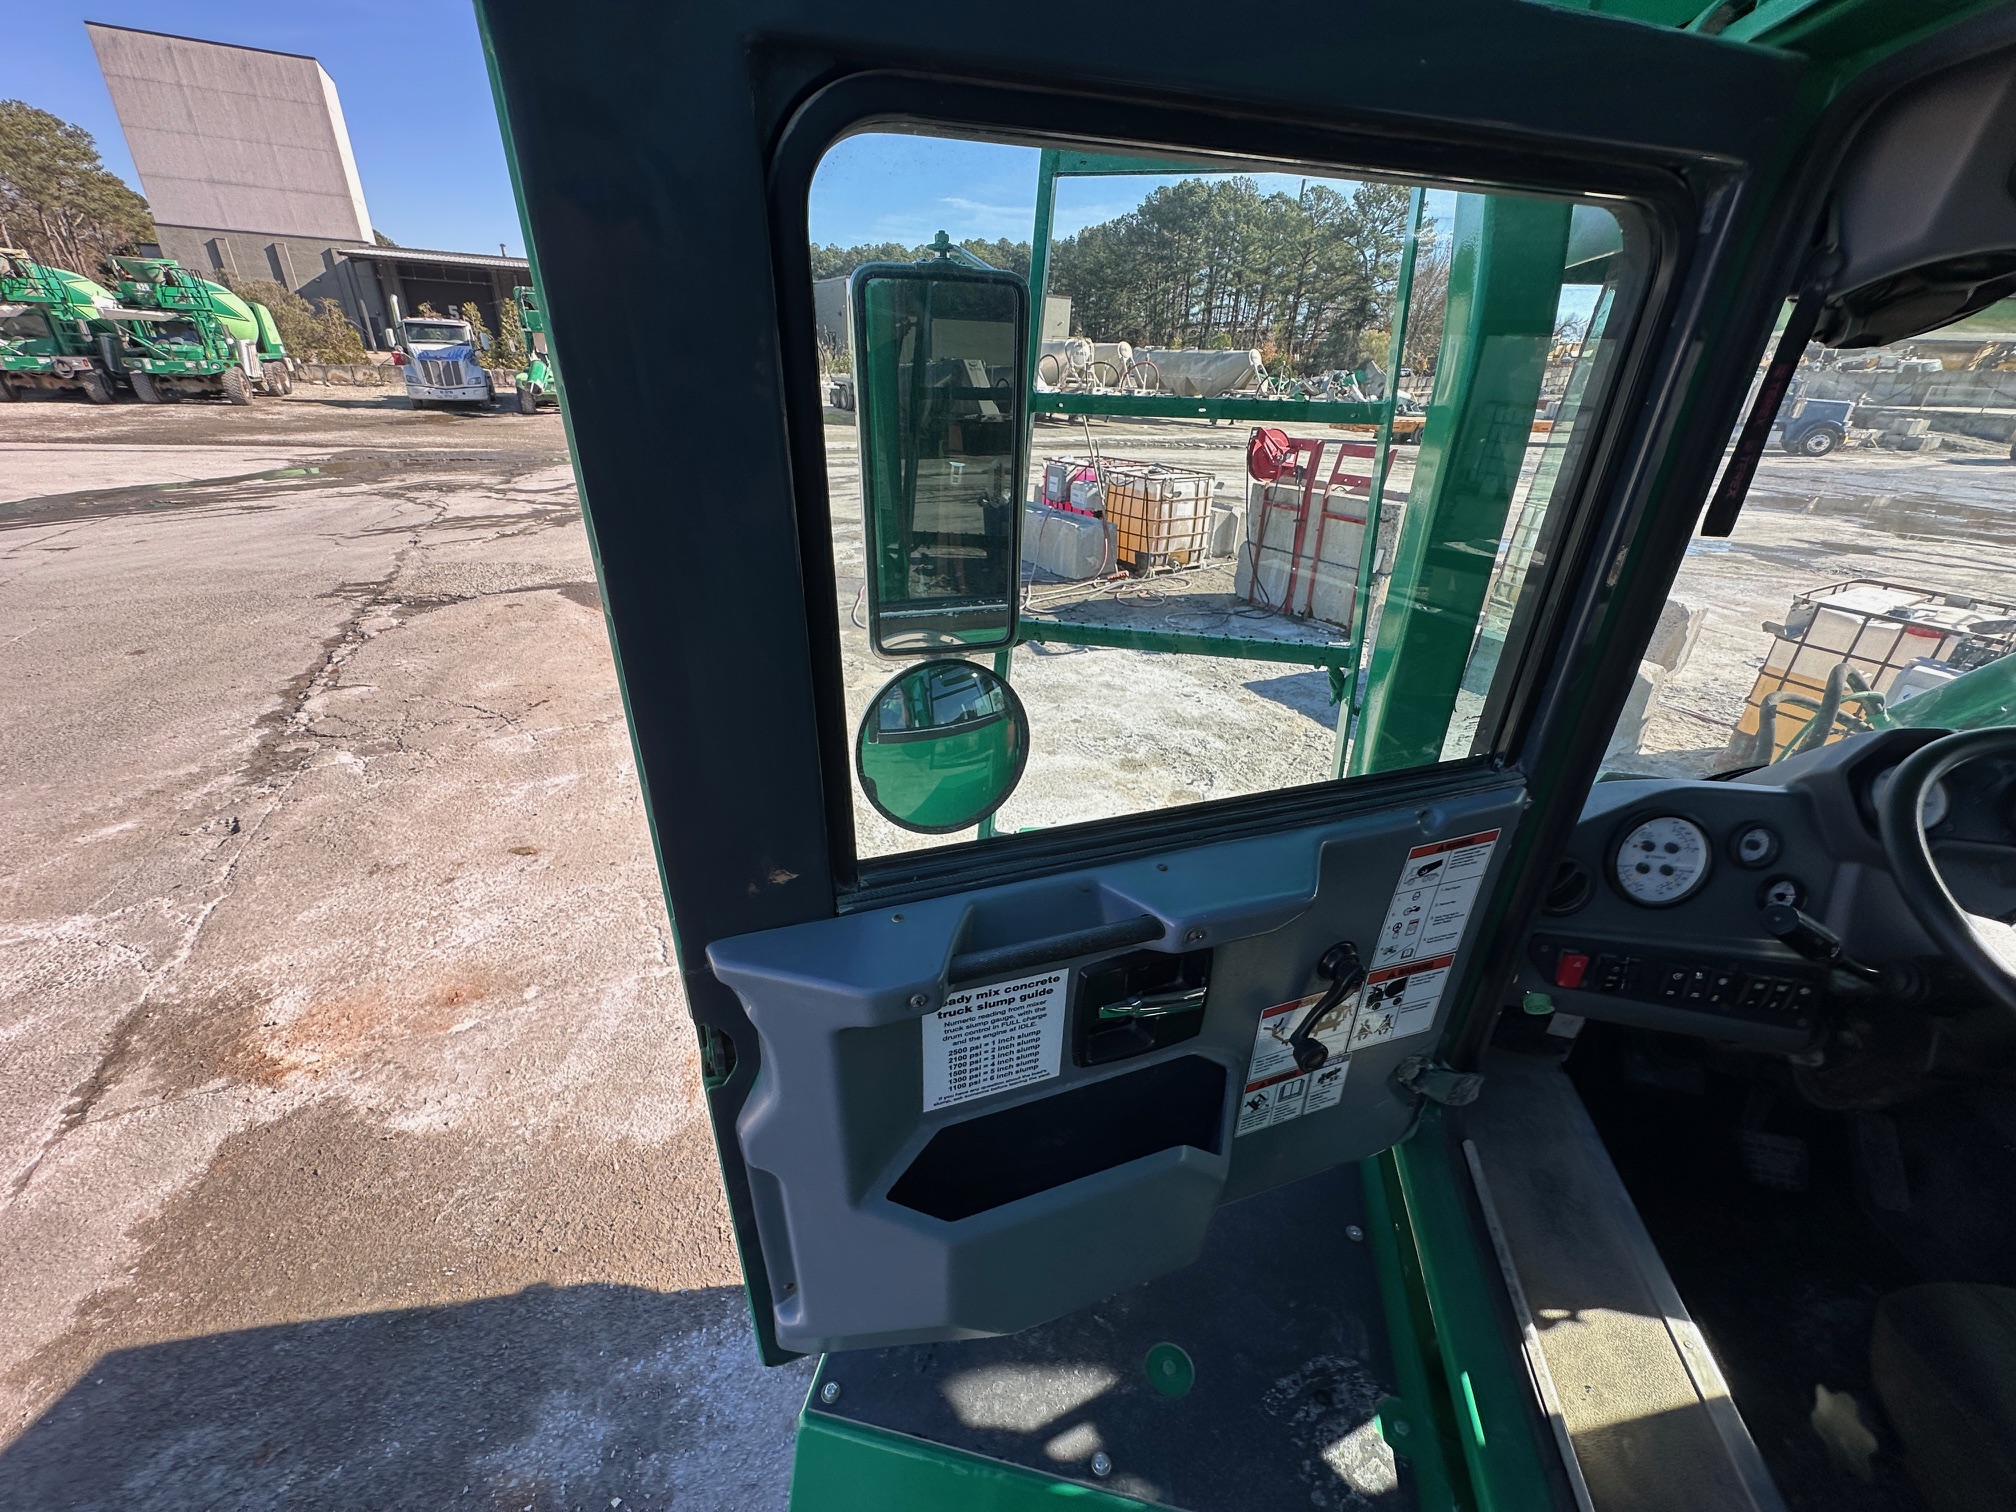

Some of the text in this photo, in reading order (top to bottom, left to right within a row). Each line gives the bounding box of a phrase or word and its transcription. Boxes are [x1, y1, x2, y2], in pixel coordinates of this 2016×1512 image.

[448, 305, 460, 320] 5
[976, 989, 1000, 1000] mix
[1004, 976, 1060, 993] concrete
[937, 988, 1054, 1019] truck slump guide
[944, 1016, 976, 1027] Numeric
[978, 1010, 1006, 1020] reading
[1027, 1000, 1047, 1008] mixer
[942, 1033, 962, 1041] drum
[964, 1027, 990, 1036] control
[1022, 1013, 1047, 1022] charge
[944, 1026, 963, 1034] truck
[965, 1020, 989, 1030] slump
[982, 1029, 1007, 1039] engine
[948, 1046, 967, 1056] 2500
[969, 1043, 982, 1052] psi
[998, 1035, 1015, 1044] inch
[1017, 1030, 1041, 1040] slump
[948, 1053, 967, 1063] 2100
[969, 1050, 982, 1060] psi
[998, 1042, 1014, 1051] inch
[1016, 1036, 1040, 1047] slump
[948, 1061, 967, 1070] 1700
[969, 1057, 981, 1067] psi
[998, 1049, 1014, 1058] inch
[1016, 1043, 1040, 1054] slump
[948, 1068, 967, 1077] 1500
[969, 1064, 981, 1074] psi
[997, 1056, 1014, 1065] inch
[1016, 1051, 1040, 1061] slump
[948, 1075, 967, 1084] 1300
[969, 1071, 981, 1081] psi
[997, 1063, 1013, 1072] inch
[1016, 1057, 1039, 1068] slump
[948, 1083, 967, 1092] 1100
[969, 1078, 980, 1087] psi
[997, 1071, 1013, 1079] inch
[1015, 1064, 1039, 1074] slump
